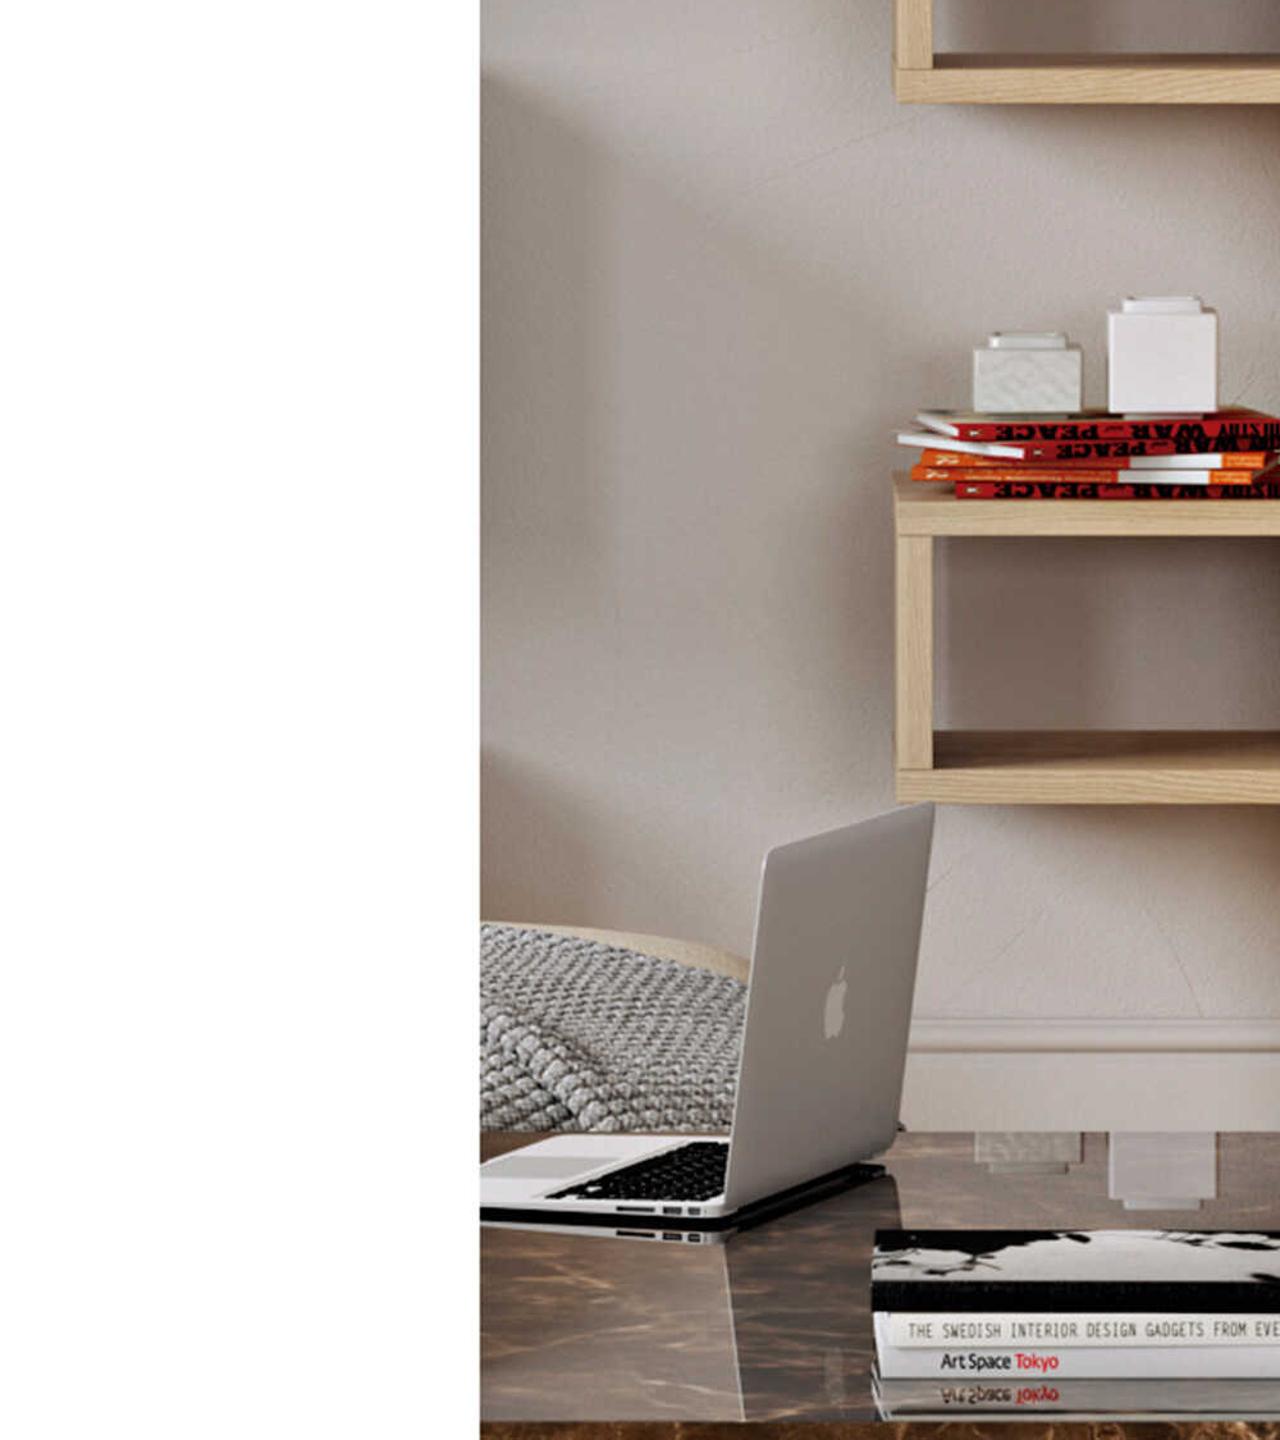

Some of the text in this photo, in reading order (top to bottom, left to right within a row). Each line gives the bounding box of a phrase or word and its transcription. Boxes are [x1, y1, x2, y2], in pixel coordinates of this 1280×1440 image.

[996, 425, 1098, 441] PEACE
[1130, 423, 1205, 440] WAR
[1056, 441, 1146, 459] PEACE
[994, 483, 1098, 499] PEACE
[1130, 483, 1206, 499] WAR
[908, 1323, 933, 1340] THE
[942, 1323, 1001, 1340] SWEDISH
[1010, 1323, 1078, 1340] INTERIOR
[1086, 1322, 1137, 1339] DESIGN
[1145, 1321, 1204, 1338] GADGETS
[1212, 1321, 1246, 1338] FROM
[941, 1353, 1060, 1372] Art Space Tokyo
